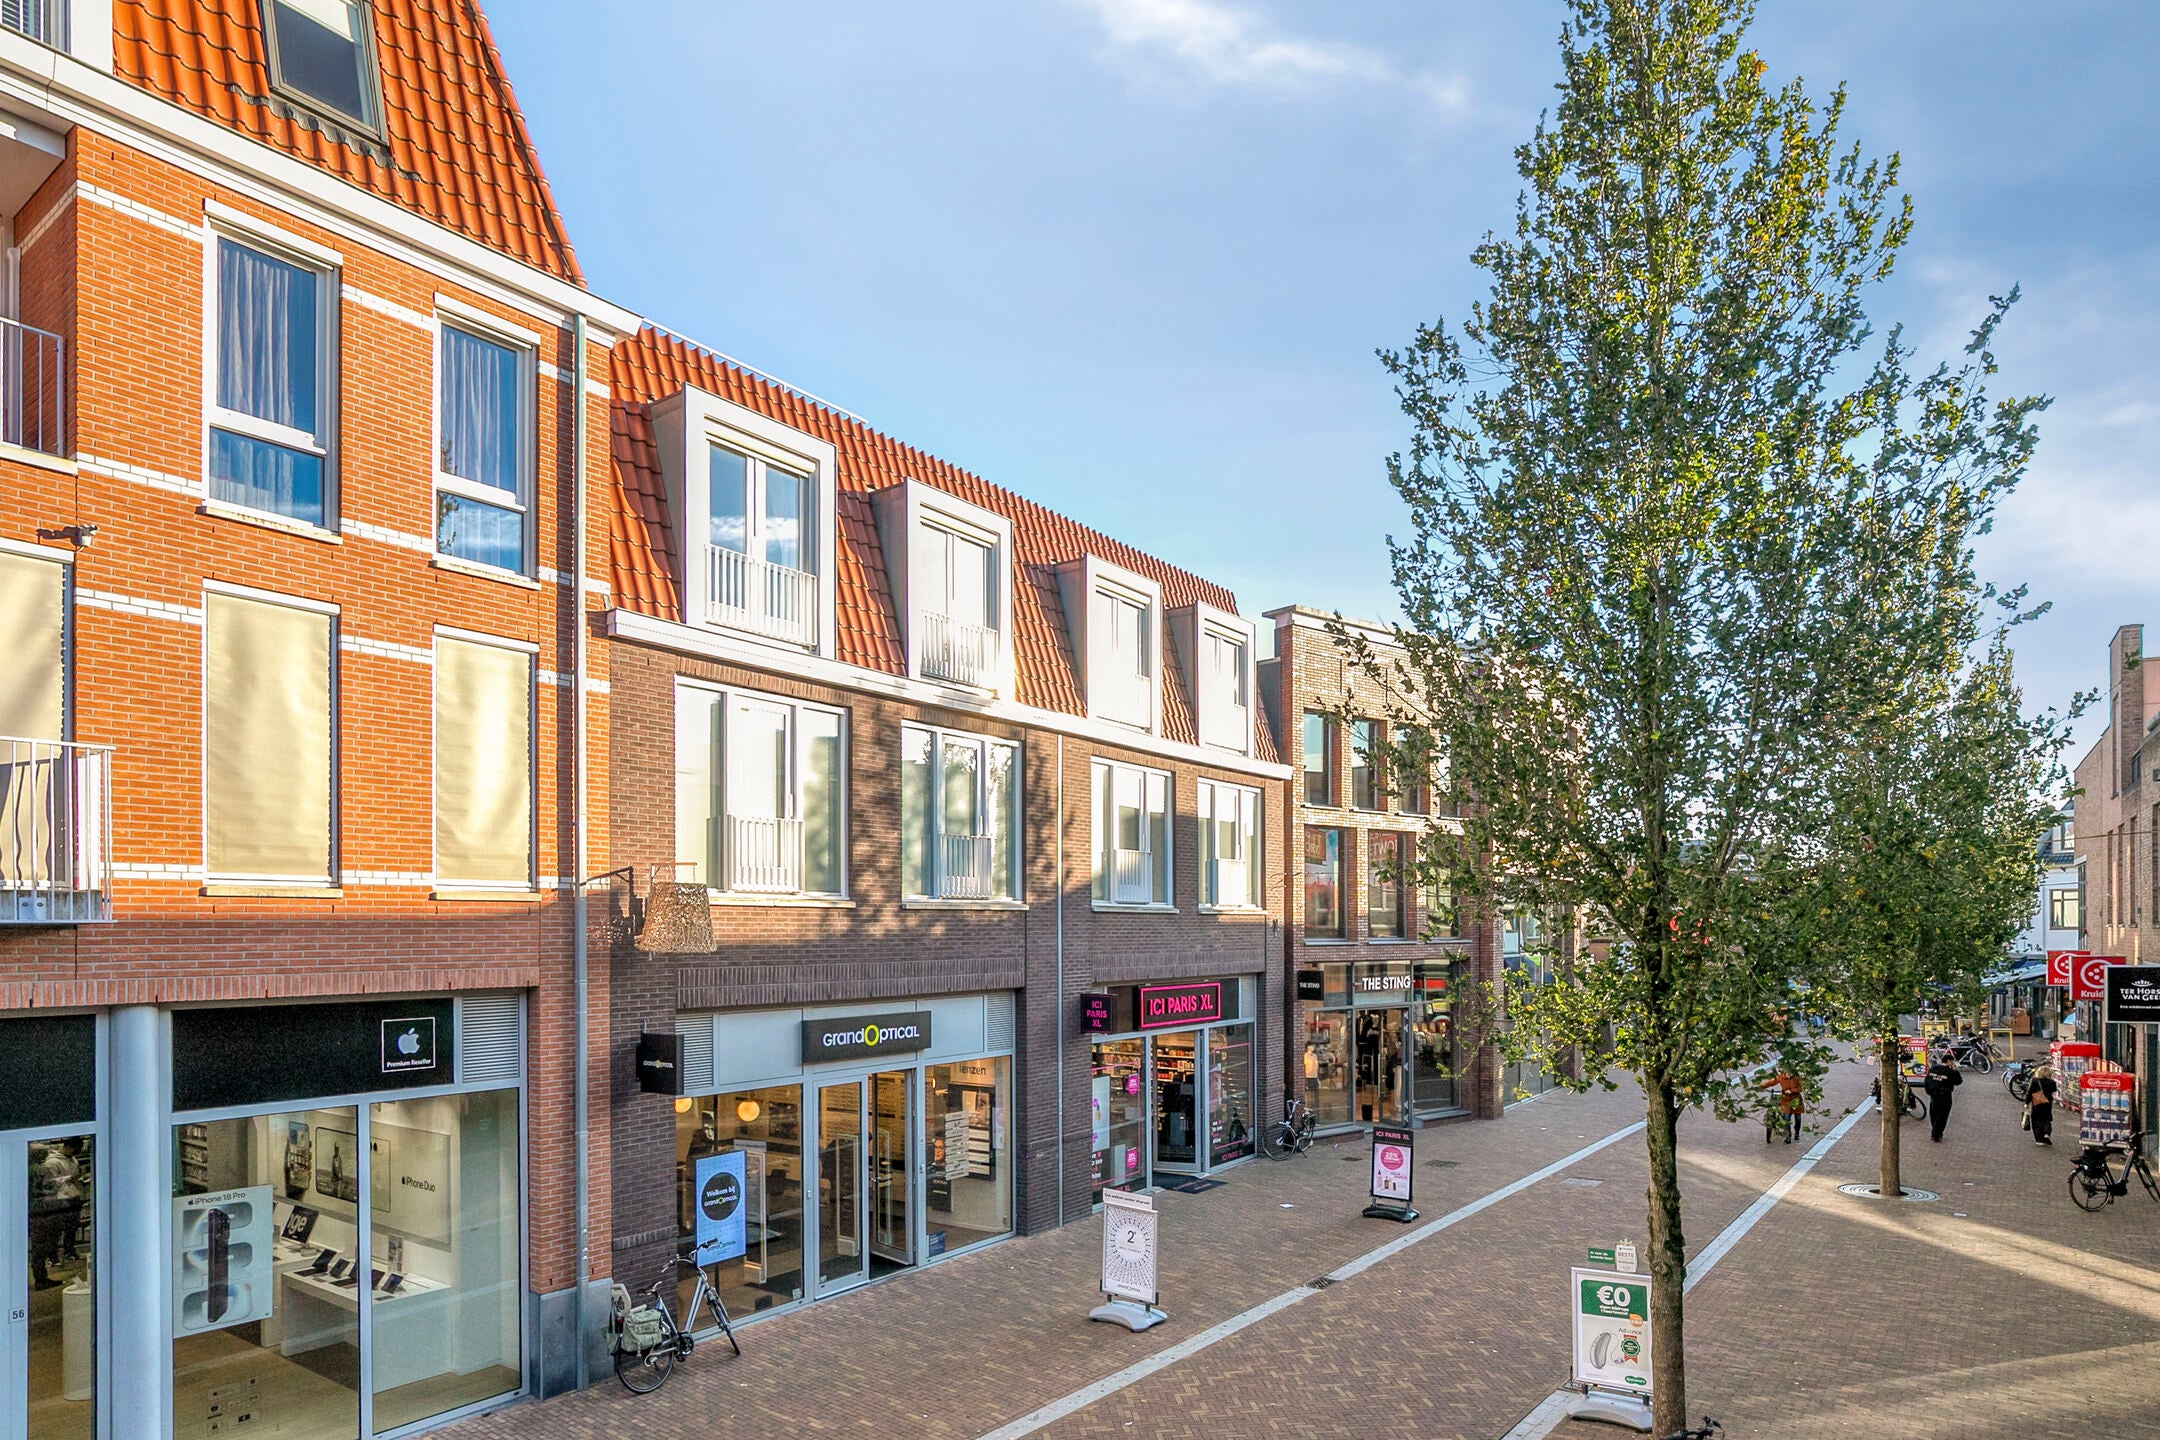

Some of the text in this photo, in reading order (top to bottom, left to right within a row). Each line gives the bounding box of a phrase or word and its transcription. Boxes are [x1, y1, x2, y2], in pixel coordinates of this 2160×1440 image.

[1362, 975, 1411, 990] THE STING
[1091, 1000, 1103, 1009] ICI
[1149, 994, 1213, 1016] ICI PARIS XL
[1086, 1010, 1108, 1019] PARIS
[1092, 1019, 1102, 1027] XL
[386, 1058, 431, 1068] Premium Reseller
[959, 1063, 987, 1076] lenzen
[706, 1185, 736, 1197] Welkom bij
[194, 1196, 222, 1205] iPhone
[233, 1192, 246, 1200] Pro
[1596, 1285, 1631, 1307] €0
[12, 1309, 25, 1320] 56
